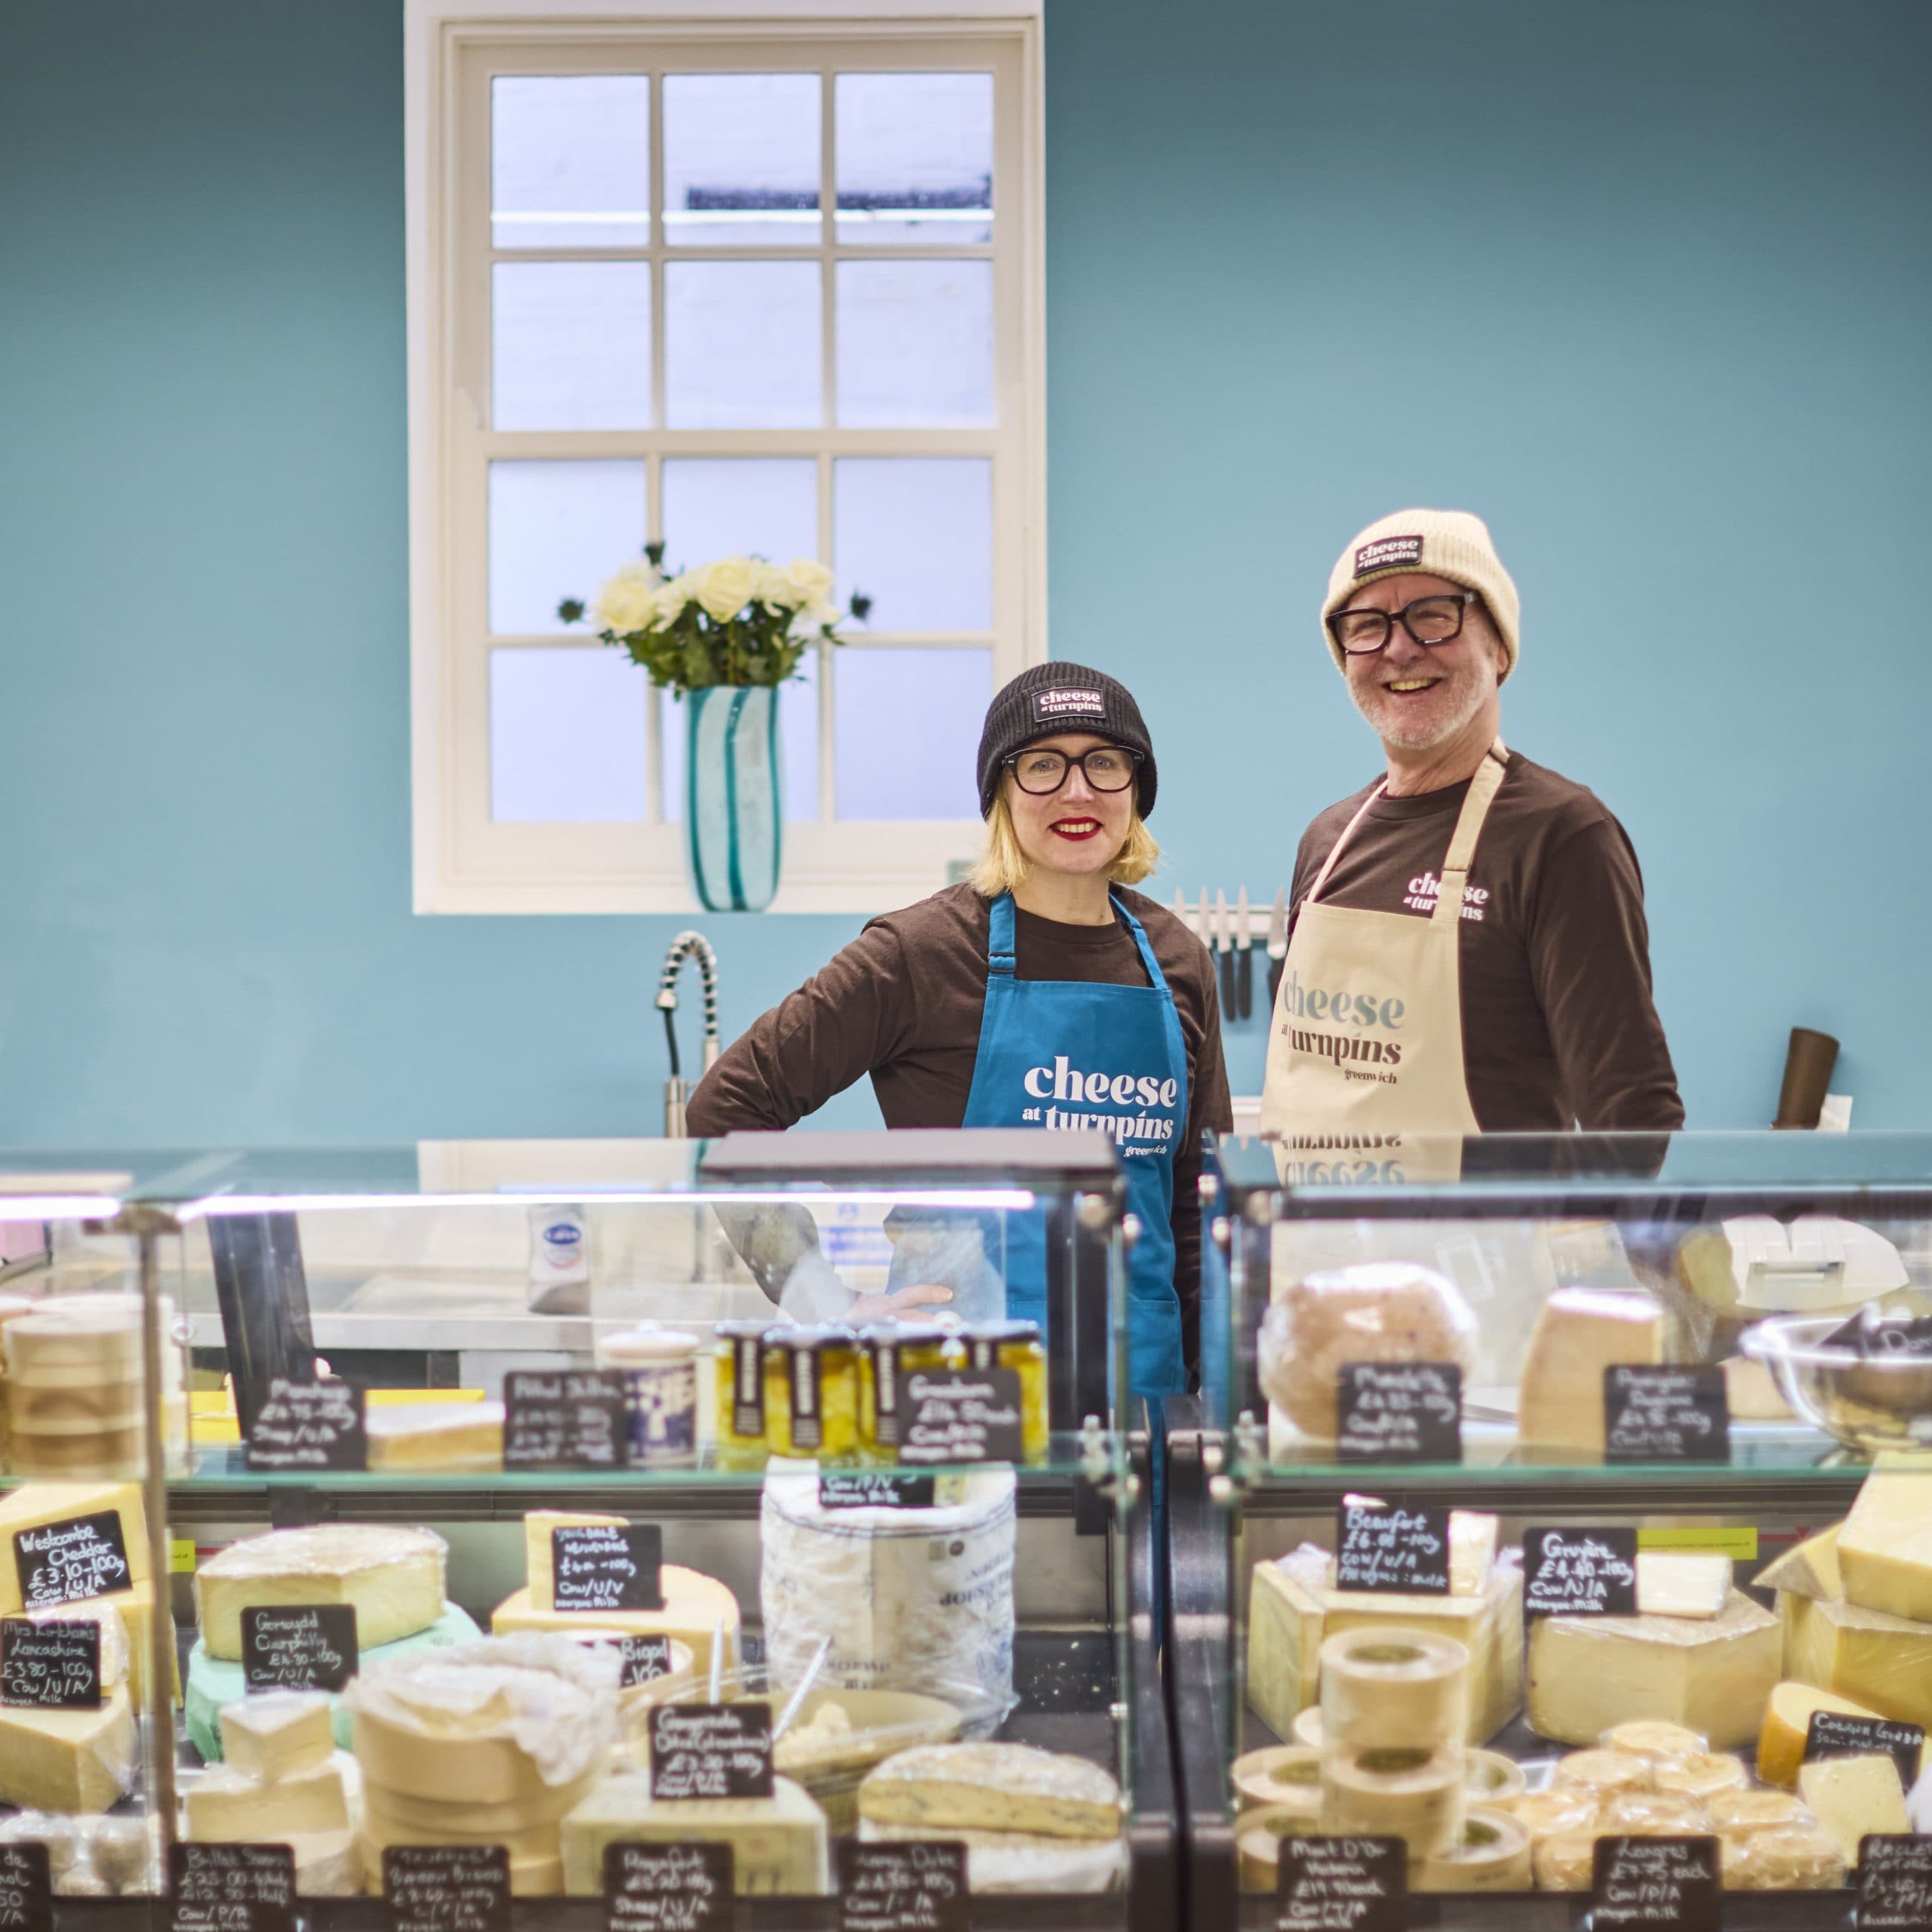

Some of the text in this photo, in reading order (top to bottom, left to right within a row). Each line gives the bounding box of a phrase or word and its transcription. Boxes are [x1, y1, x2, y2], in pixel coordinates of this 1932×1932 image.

[1358, 540, 1419, 561] cheese
[1364, 550, 1418, 568] turnpins
[1040, 691, 1100, 705] cheese
[1048, 702, 1102, 712] turnpins
[1408, 872, 1488, 904] chese
[1283, 971, 1405, 1030] cheese
[1281, 1023, 1401, 1066] at turnpins
[1024, 1056, 1177, 1108] cheese
[1344, 1068, 1397, 1084] greenwich
[1022, 1105, 1174, 1145] at turnpins
[20, 1525, 100, 1552] Westcombe
[48, 1541, 112, 1566] Cheddar
[4, 1622, 31, 1636] Mrs
[11, 1638, 87, 1657] Lancashire
[621, 1637, 667, 1666] Bigod
